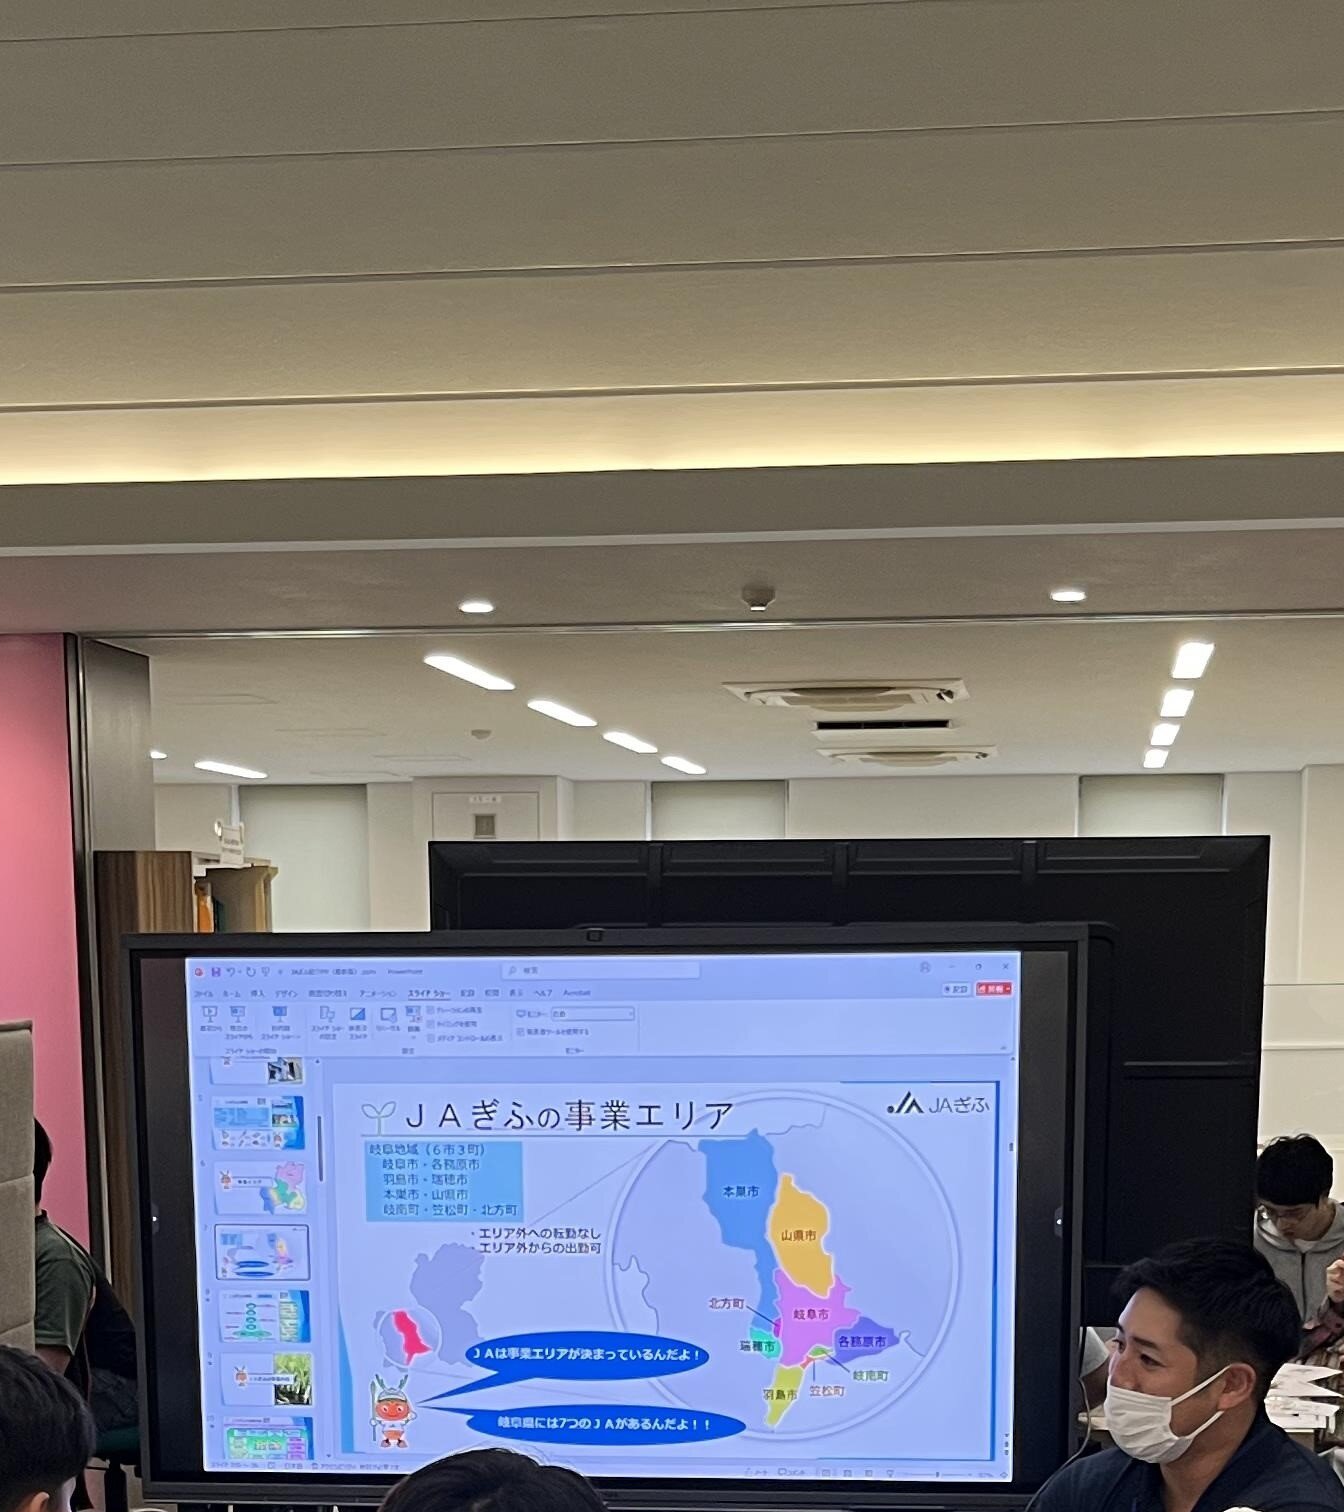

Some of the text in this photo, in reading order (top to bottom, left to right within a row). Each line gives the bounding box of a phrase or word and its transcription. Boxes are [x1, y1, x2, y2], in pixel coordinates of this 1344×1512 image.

[928, 1096, 990, 1114] JAぎふ
[406, 1098, 734, 1132] JAぎふの事業エリア
[723, 1186, 760, 1198] 本巣市
[781, 1229, 817, 1242] 山県市
[709, 1298, 745, 1310] 北方町
[793, 1308, 829, 1321] 岐阜市
[763, 1388, 798, 1401] 羽島市
